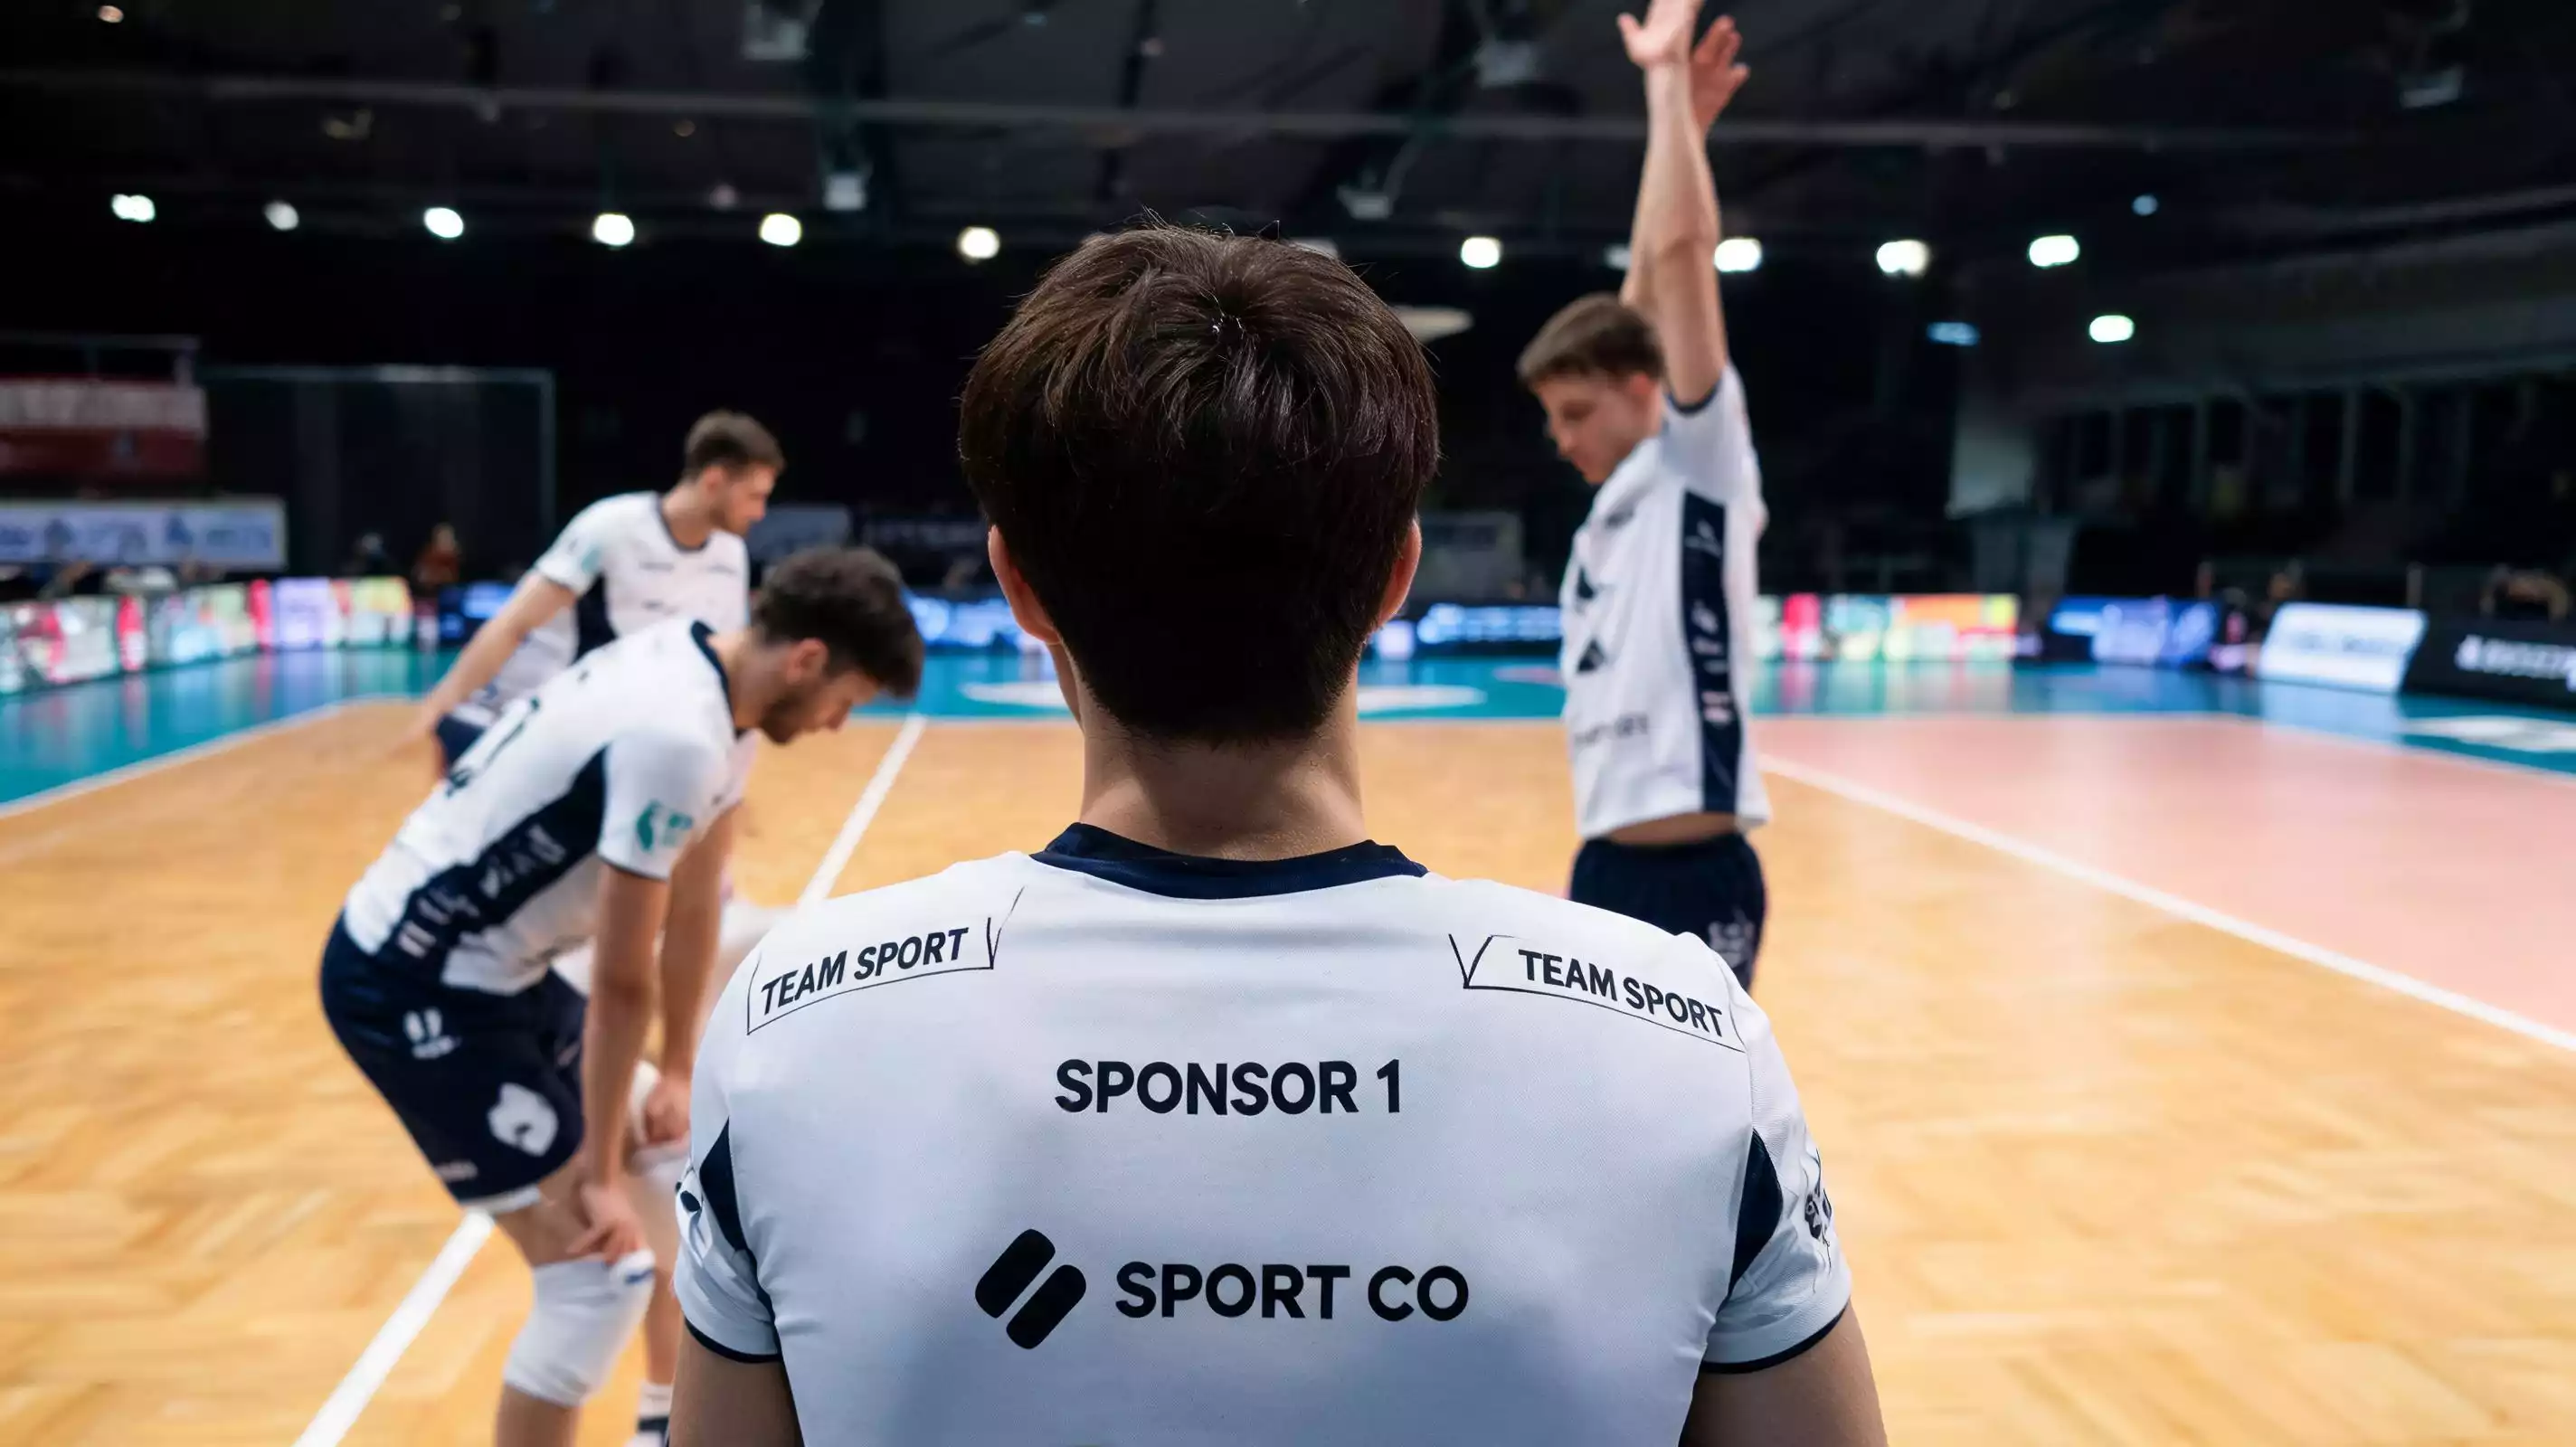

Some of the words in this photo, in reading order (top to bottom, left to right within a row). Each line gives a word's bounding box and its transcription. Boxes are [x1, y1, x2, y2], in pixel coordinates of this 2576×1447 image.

[761, 950, 848, 1016] TEAM
[853, 927, 970, 980] SPORT
[1518, 949, 1618, 1002] TEAM
[1623, 977, 1722, 1037] SPORT
[1055, 1058, 1359, 1116] SPONSOR
[1376, 1058, 1400, 1114] 1
[1114, 1261, 1351, 1320] SPORT
[1367, 1264, 1470, 1323] CO
